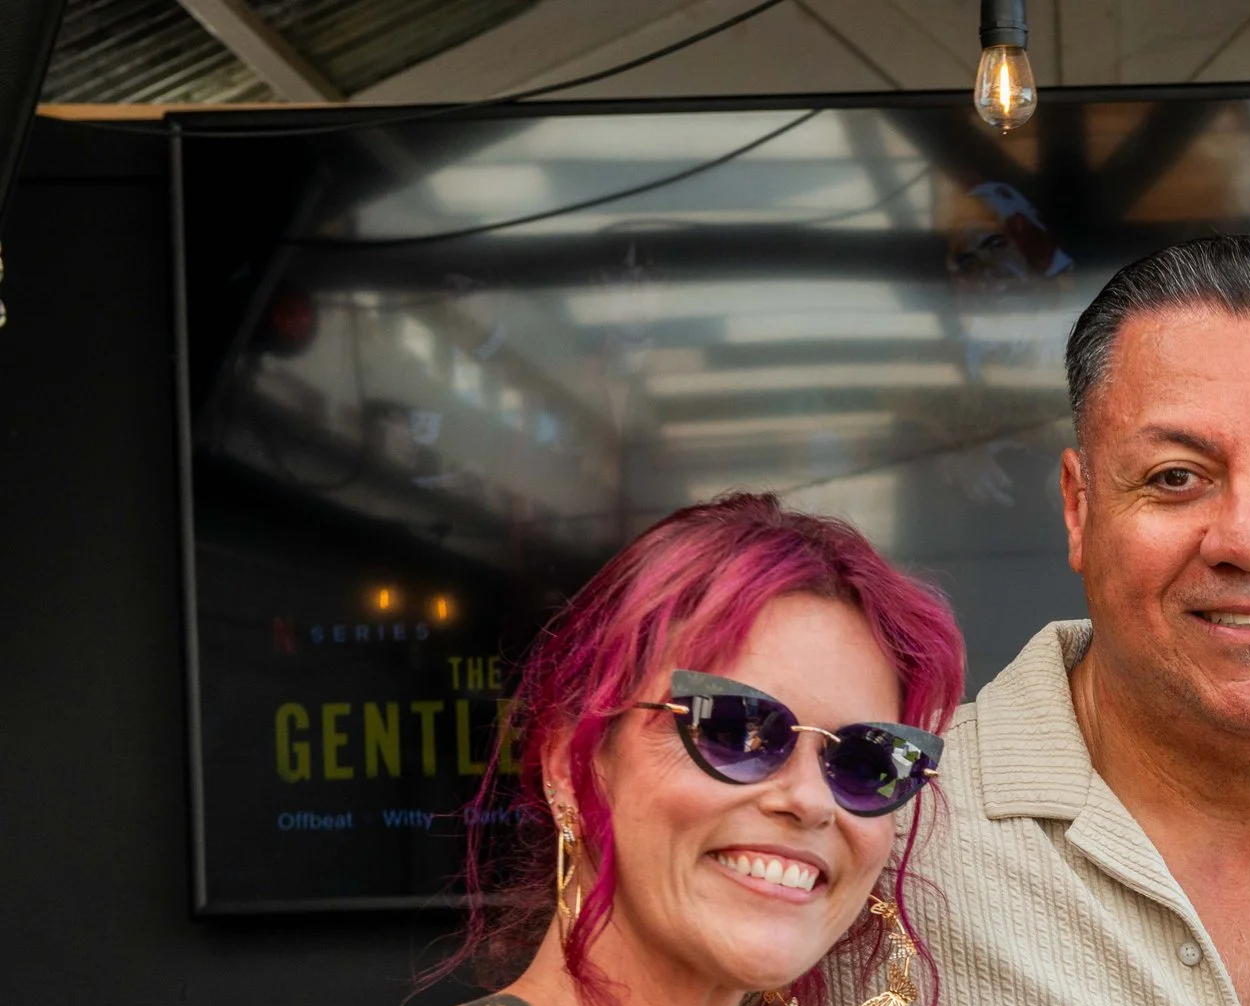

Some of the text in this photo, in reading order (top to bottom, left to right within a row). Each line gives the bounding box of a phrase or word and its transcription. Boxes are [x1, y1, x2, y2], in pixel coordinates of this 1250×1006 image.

[309, 622, 431, 645] SERIES
[447, 655, 504, 691] THE
[276, 809, 354, 832] Offbeat
[382, 807, 435, 831] Witty
